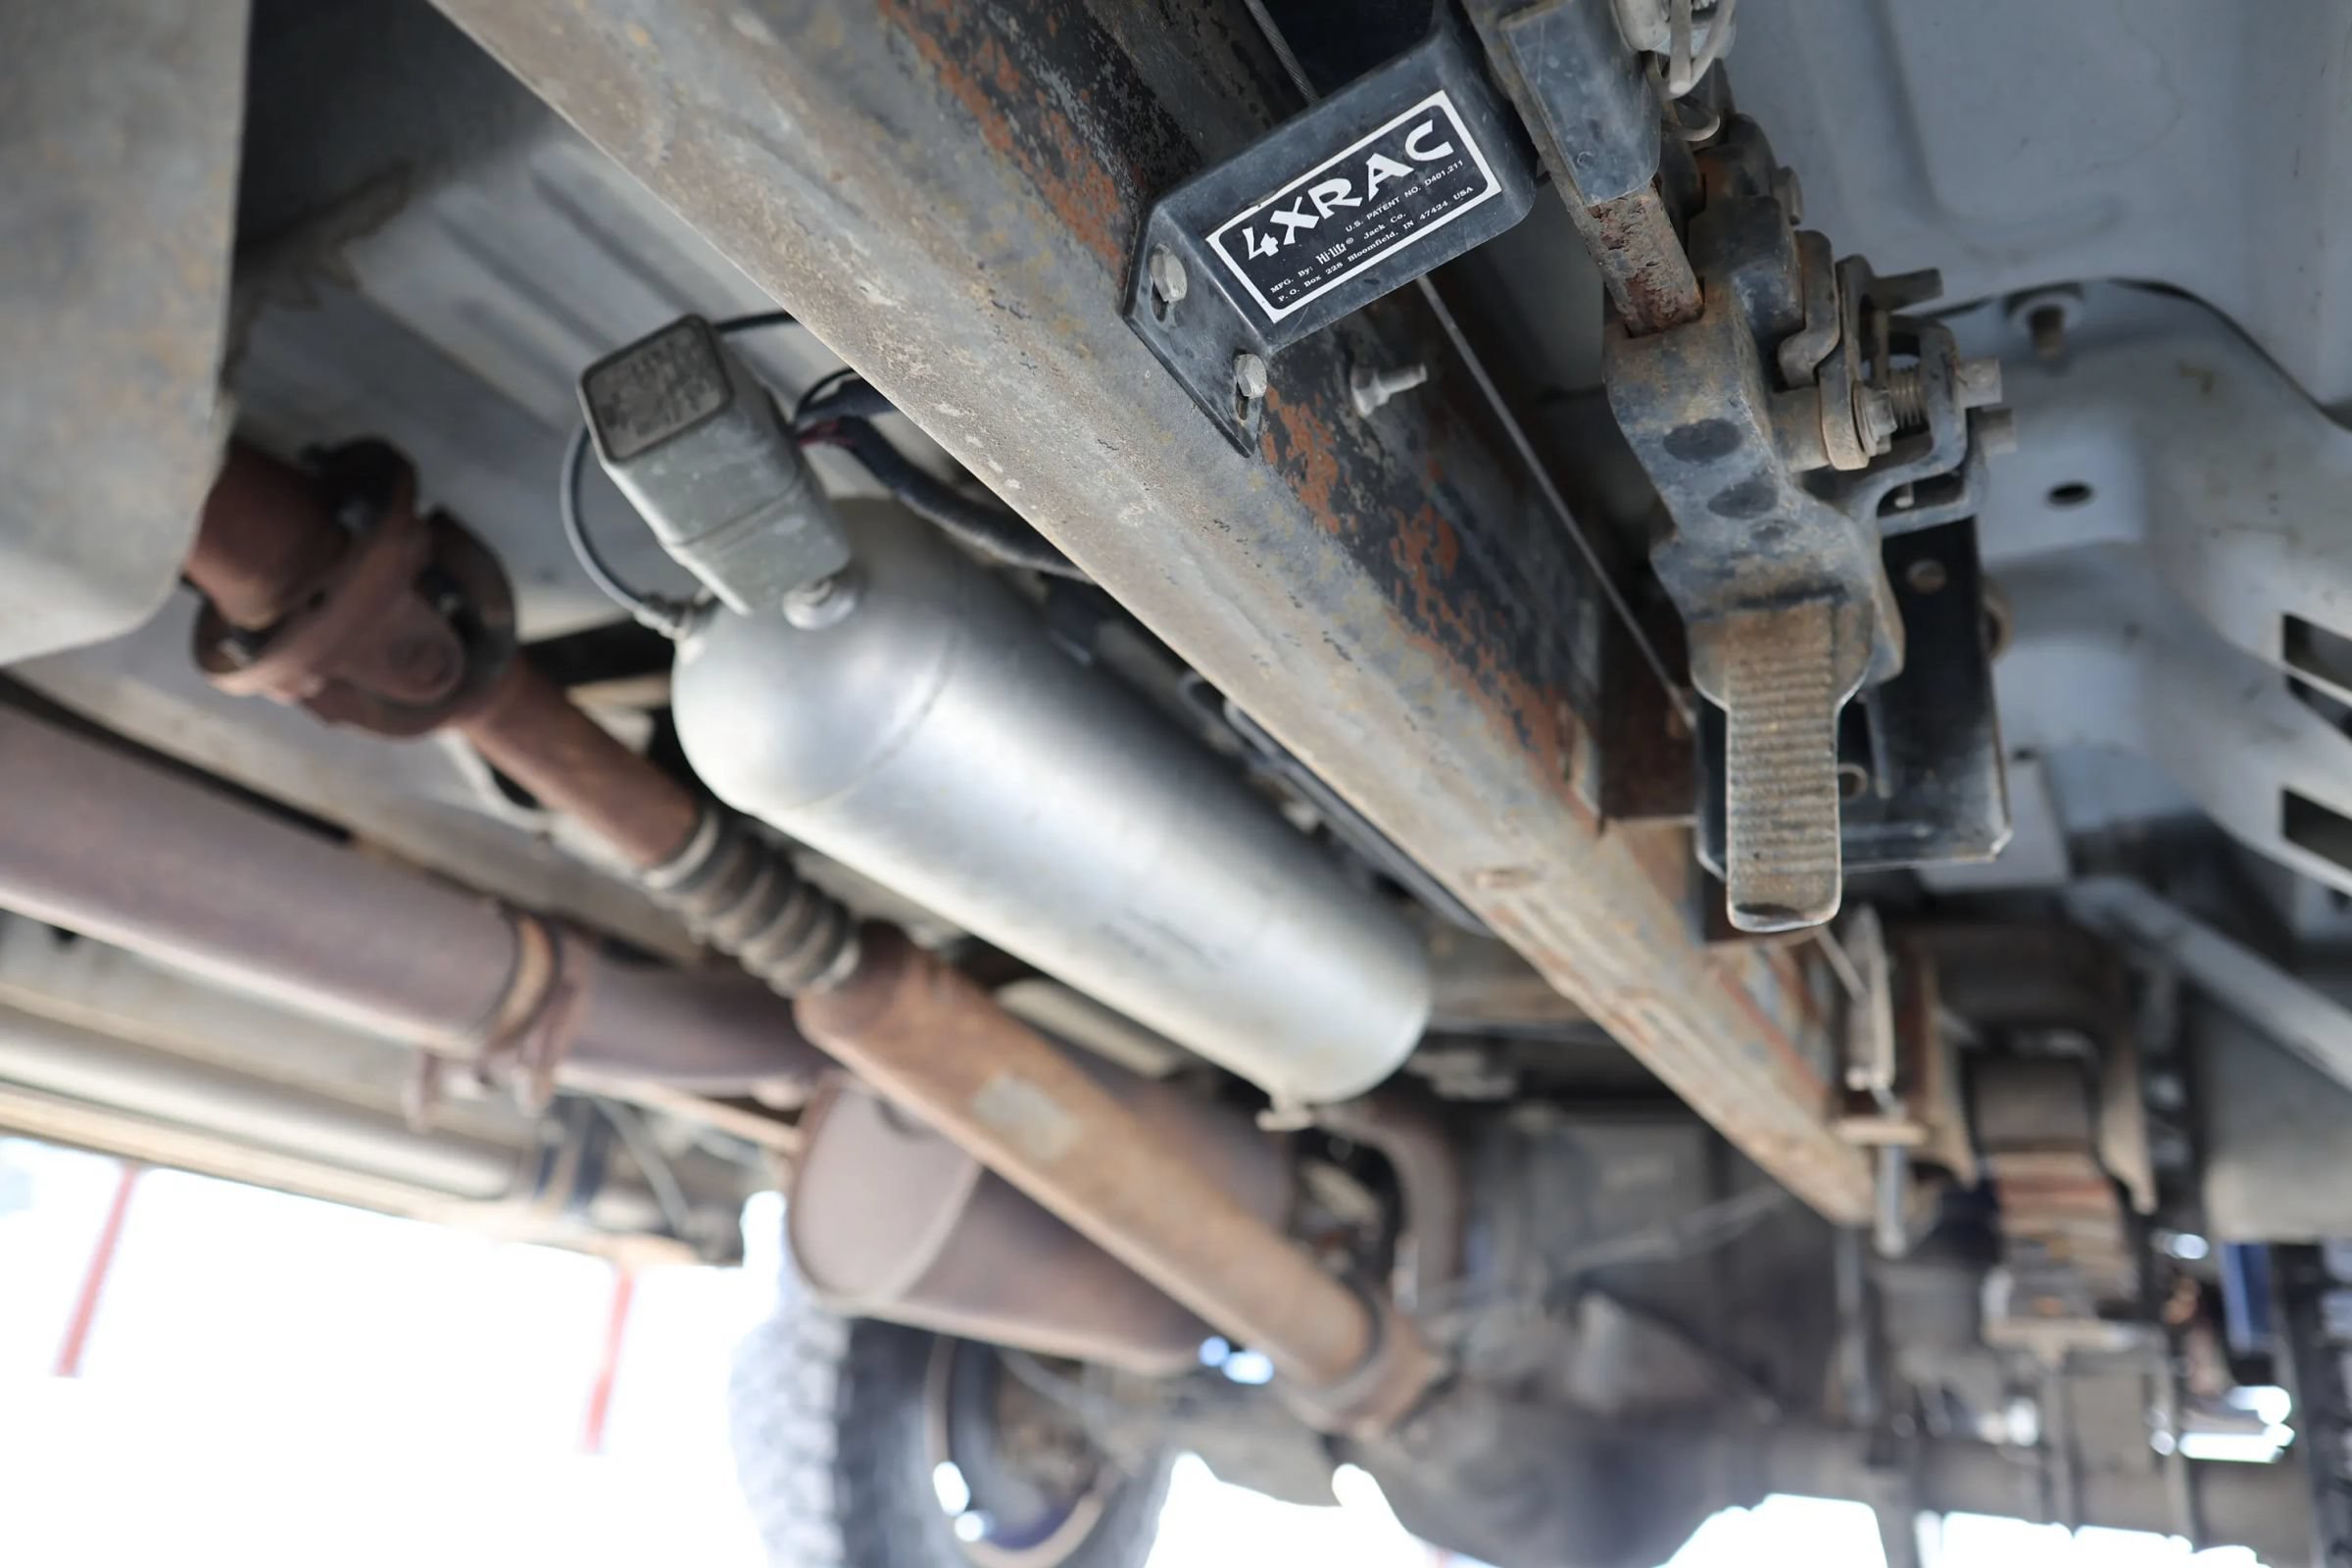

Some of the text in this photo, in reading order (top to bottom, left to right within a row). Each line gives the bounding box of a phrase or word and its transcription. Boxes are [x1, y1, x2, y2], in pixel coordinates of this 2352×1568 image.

[1242, 120, 1454, 260] 4XRAC
[1345, 220, 1364, 232] U.S.
[1366, 197, 1400, 220] PATENT
[1403, 186, 1421, 198] NO.
[1270, 278, 1294, 293] MFG.
[1298, 266, 1313, 277] By:
[1363, 223, 1386, 240] Jack
[1390, 213, 1406, 223] Co.
[1303, 274, 1322, 287] Box
[1325, 262, 1344, 275] 228
[1402, 220, 1414, 231] IN
[1419, 200, 1448, 220] 47424
[1452, 186, 1474, 200] USA
